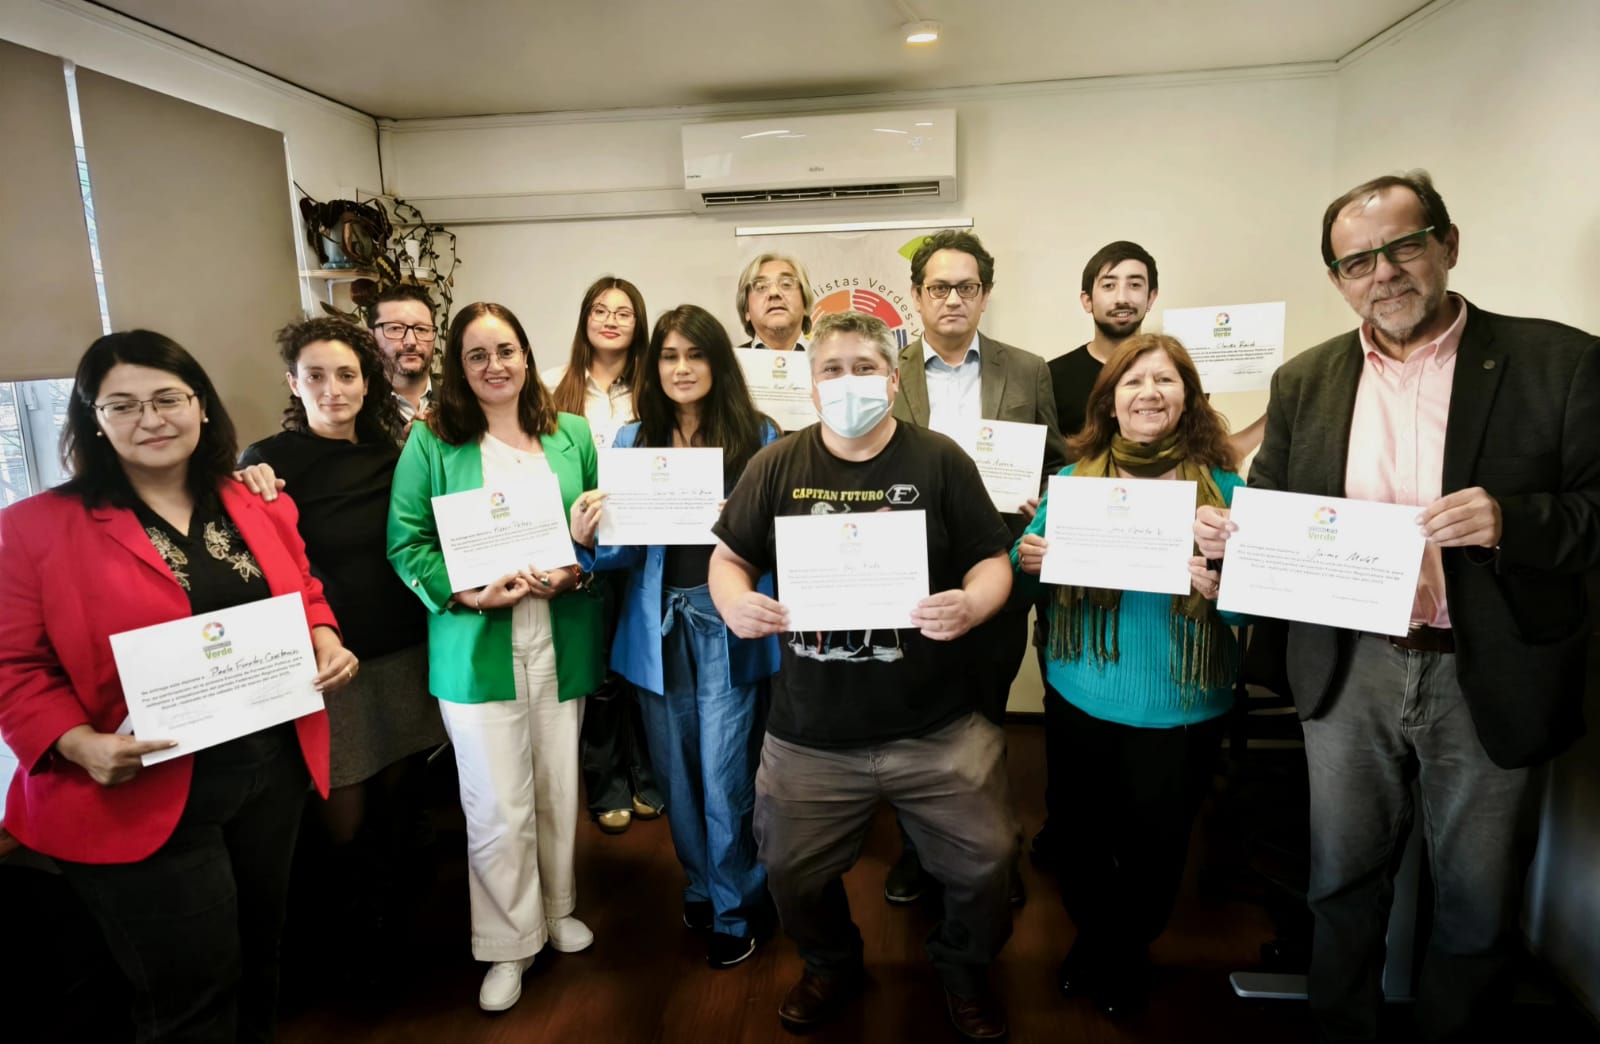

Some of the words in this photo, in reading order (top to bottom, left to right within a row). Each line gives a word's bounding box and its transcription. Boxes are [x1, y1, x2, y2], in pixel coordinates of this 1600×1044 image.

[813, 278, 859, 297] listas
[792, 487, 838, 502] CAPITAN
[840, 488, 884, 502] FUTURO
[893, 486, 912, 502] F
[204, 646, 233, 660] Verde
